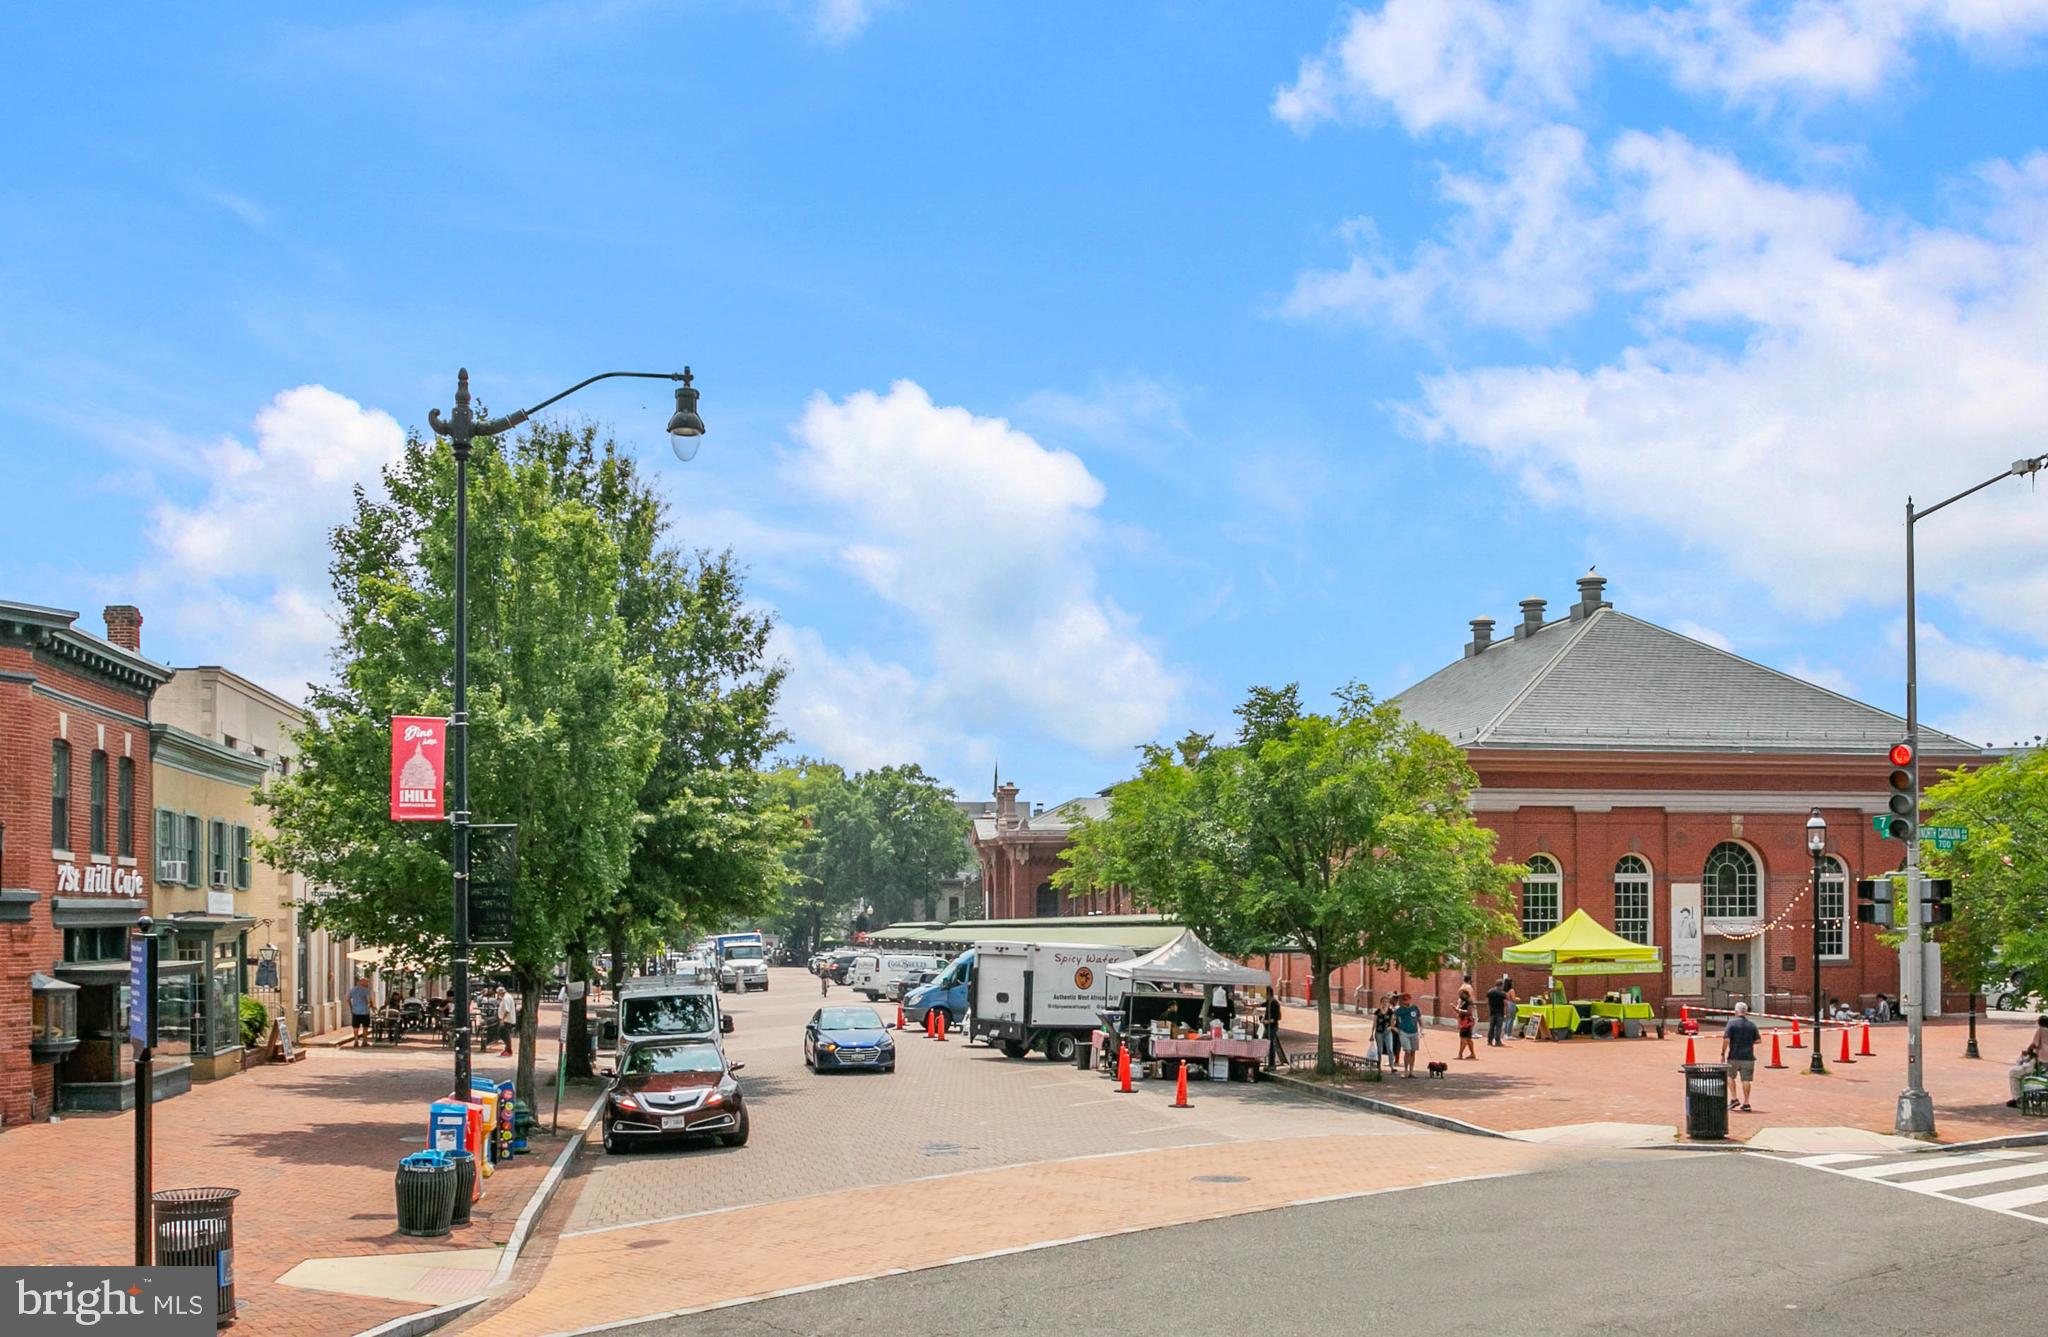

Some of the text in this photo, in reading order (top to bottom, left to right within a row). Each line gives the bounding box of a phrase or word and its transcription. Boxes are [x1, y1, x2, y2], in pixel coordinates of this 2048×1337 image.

[1937, 827, 1961, 840] CAROLINA
[1939, 840, 1952, 849] 700
[83, 864, 112, 894] Hill
[114, 869, 144, 898] Cafe
[1054, 953, 1082, 966] Spicy
